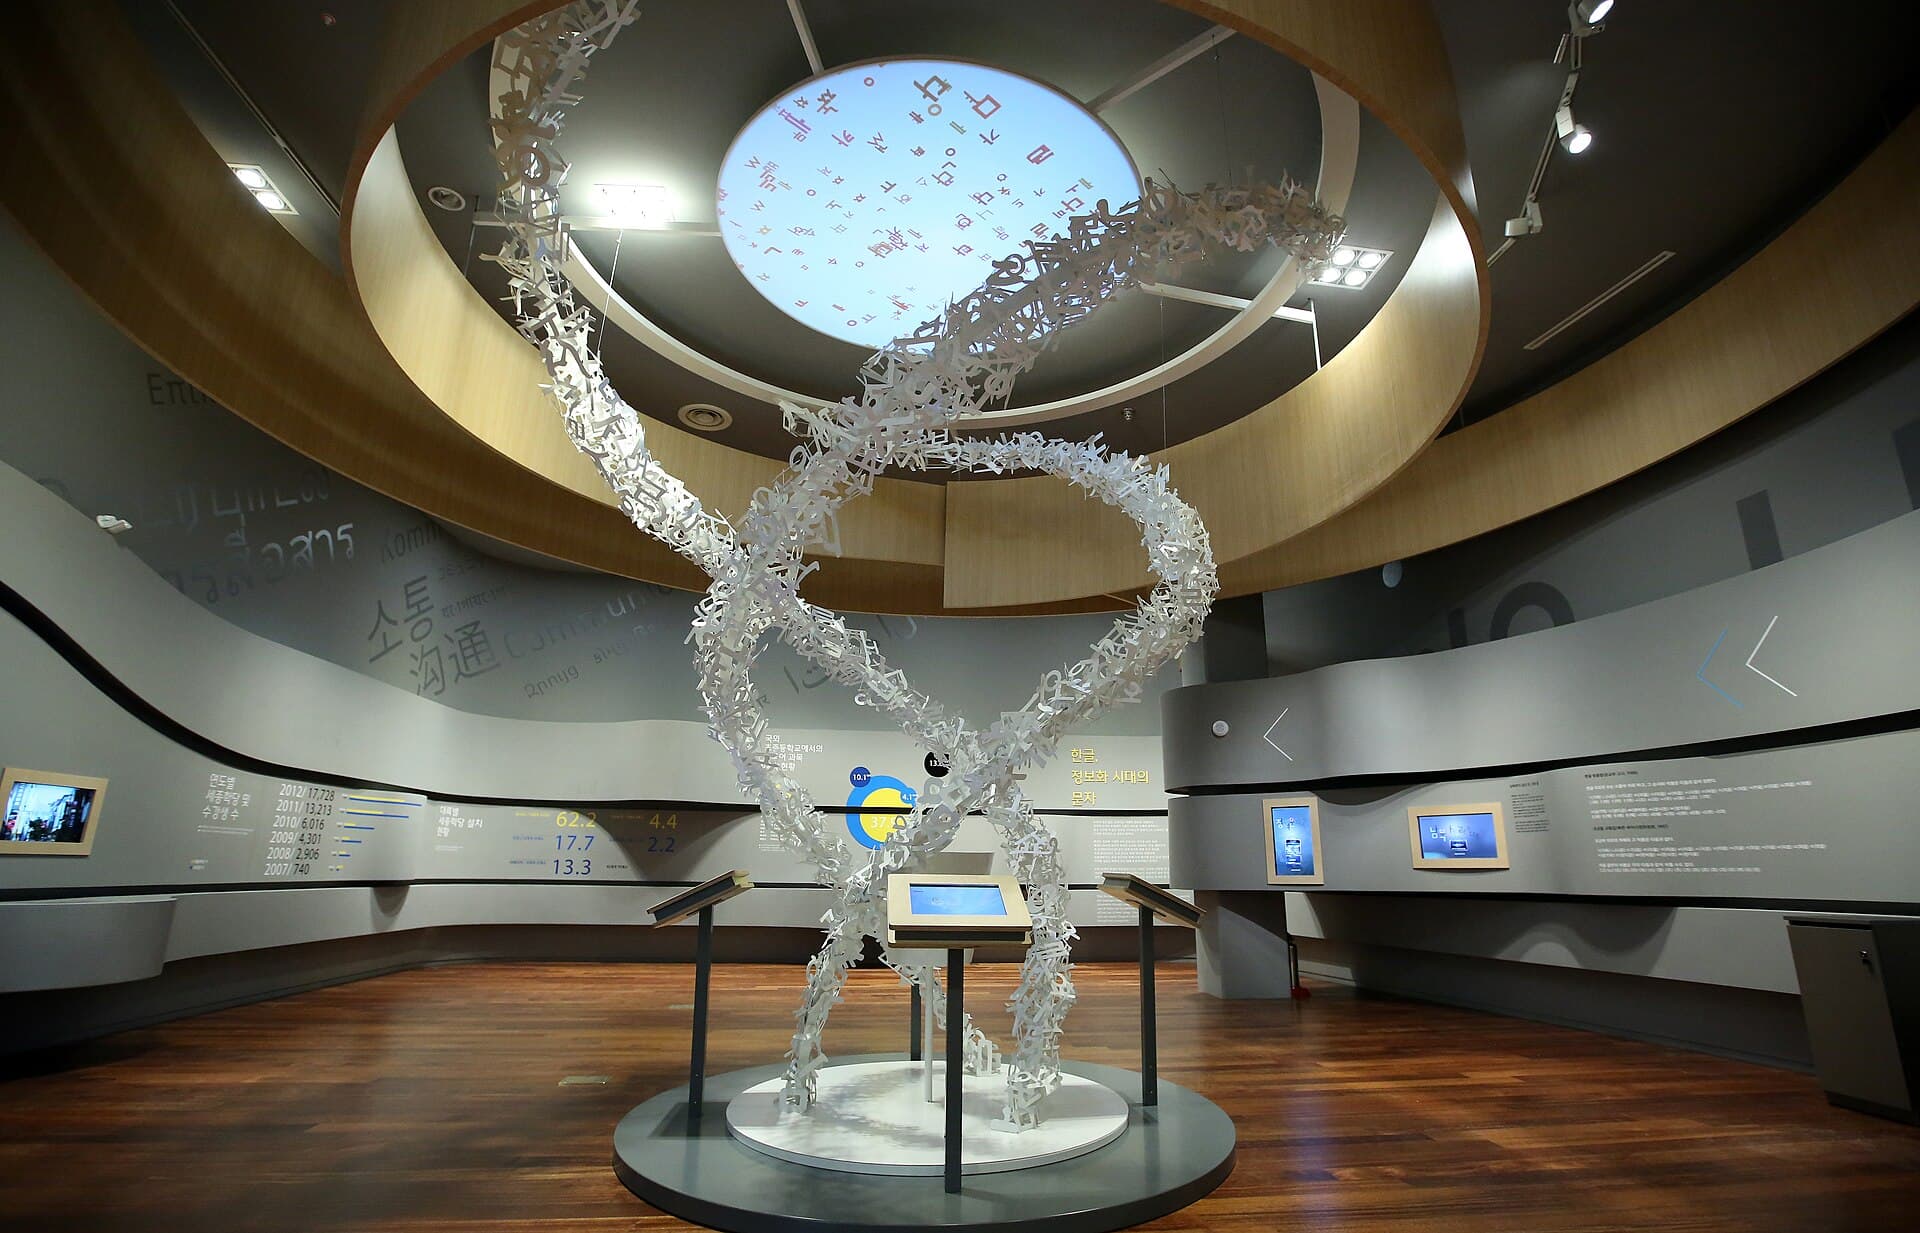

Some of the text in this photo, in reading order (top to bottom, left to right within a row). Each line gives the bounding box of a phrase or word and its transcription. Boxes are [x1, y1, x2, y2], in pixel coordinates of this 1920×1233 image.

[368, 576, 434, 664] 소통
[1071, 748, 1099, 764] 한글,
[1071, 769, 1150, 785] 정보화 시대의
[1072, 791, 1097, 807] 문자
[556, 811, 596, 828] 62.2
[649, 813, 678, 829] 4.4
[556, 834, 595, 851] 17.7
[648, 836, 676, 853] 2.2
[553, 859, 592, 876] 13.3
